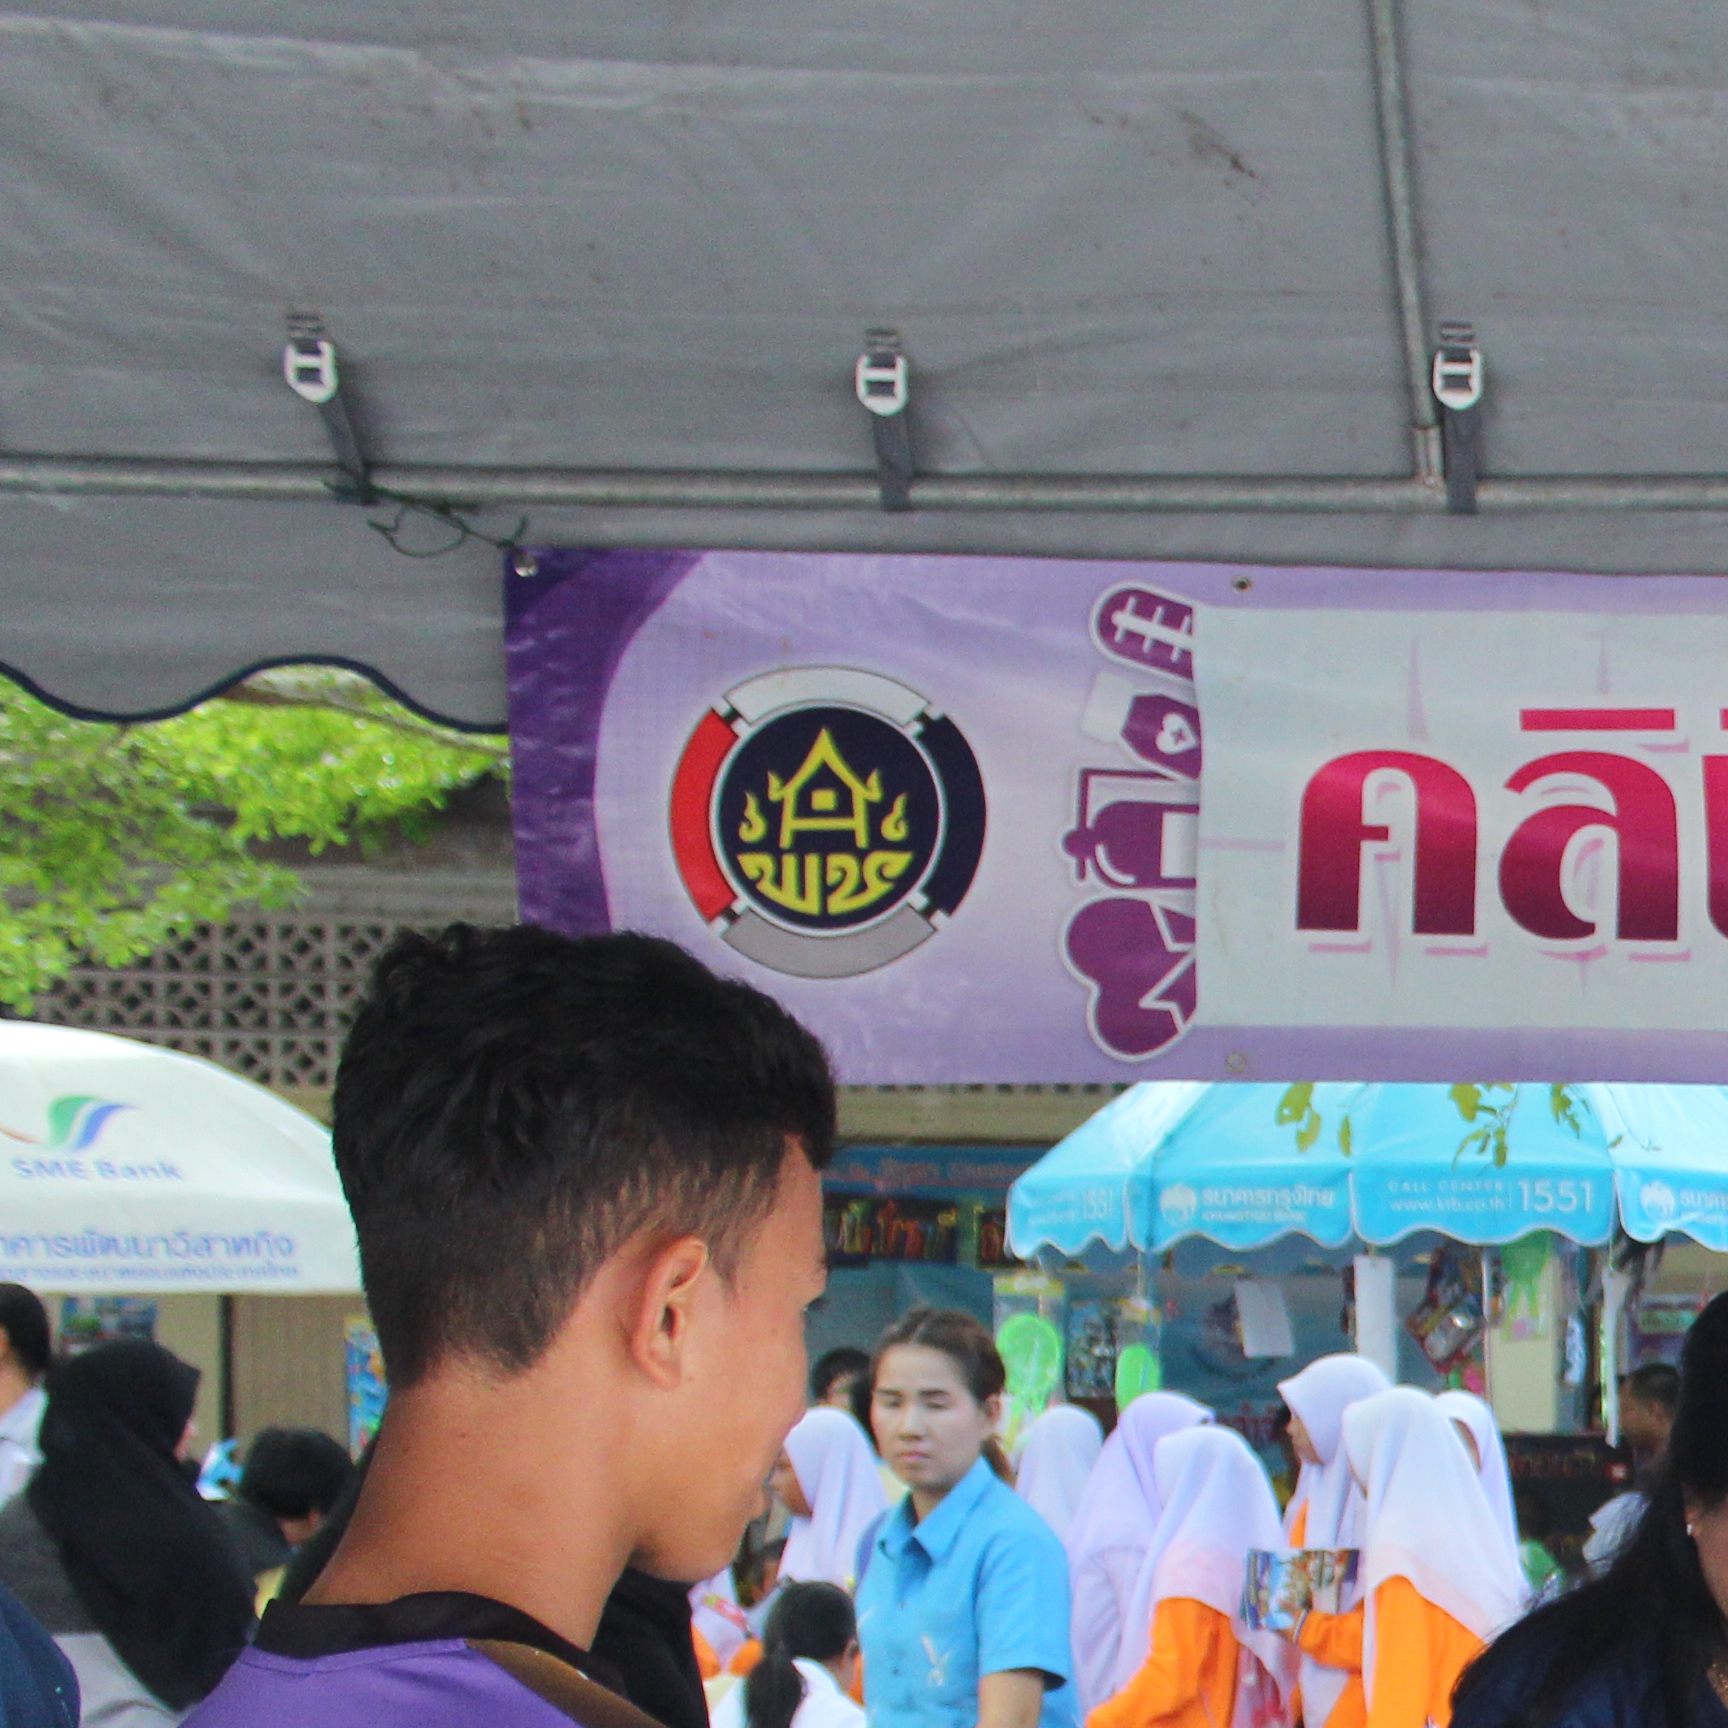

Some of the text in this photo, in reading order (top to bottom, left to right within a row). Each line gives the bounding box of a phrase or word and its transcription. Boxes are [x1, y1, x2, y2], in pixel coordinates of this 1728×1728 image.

[11, 1159, 184, 1181] SME Bank
[1518, 1178, 1592, 1213] 1551
